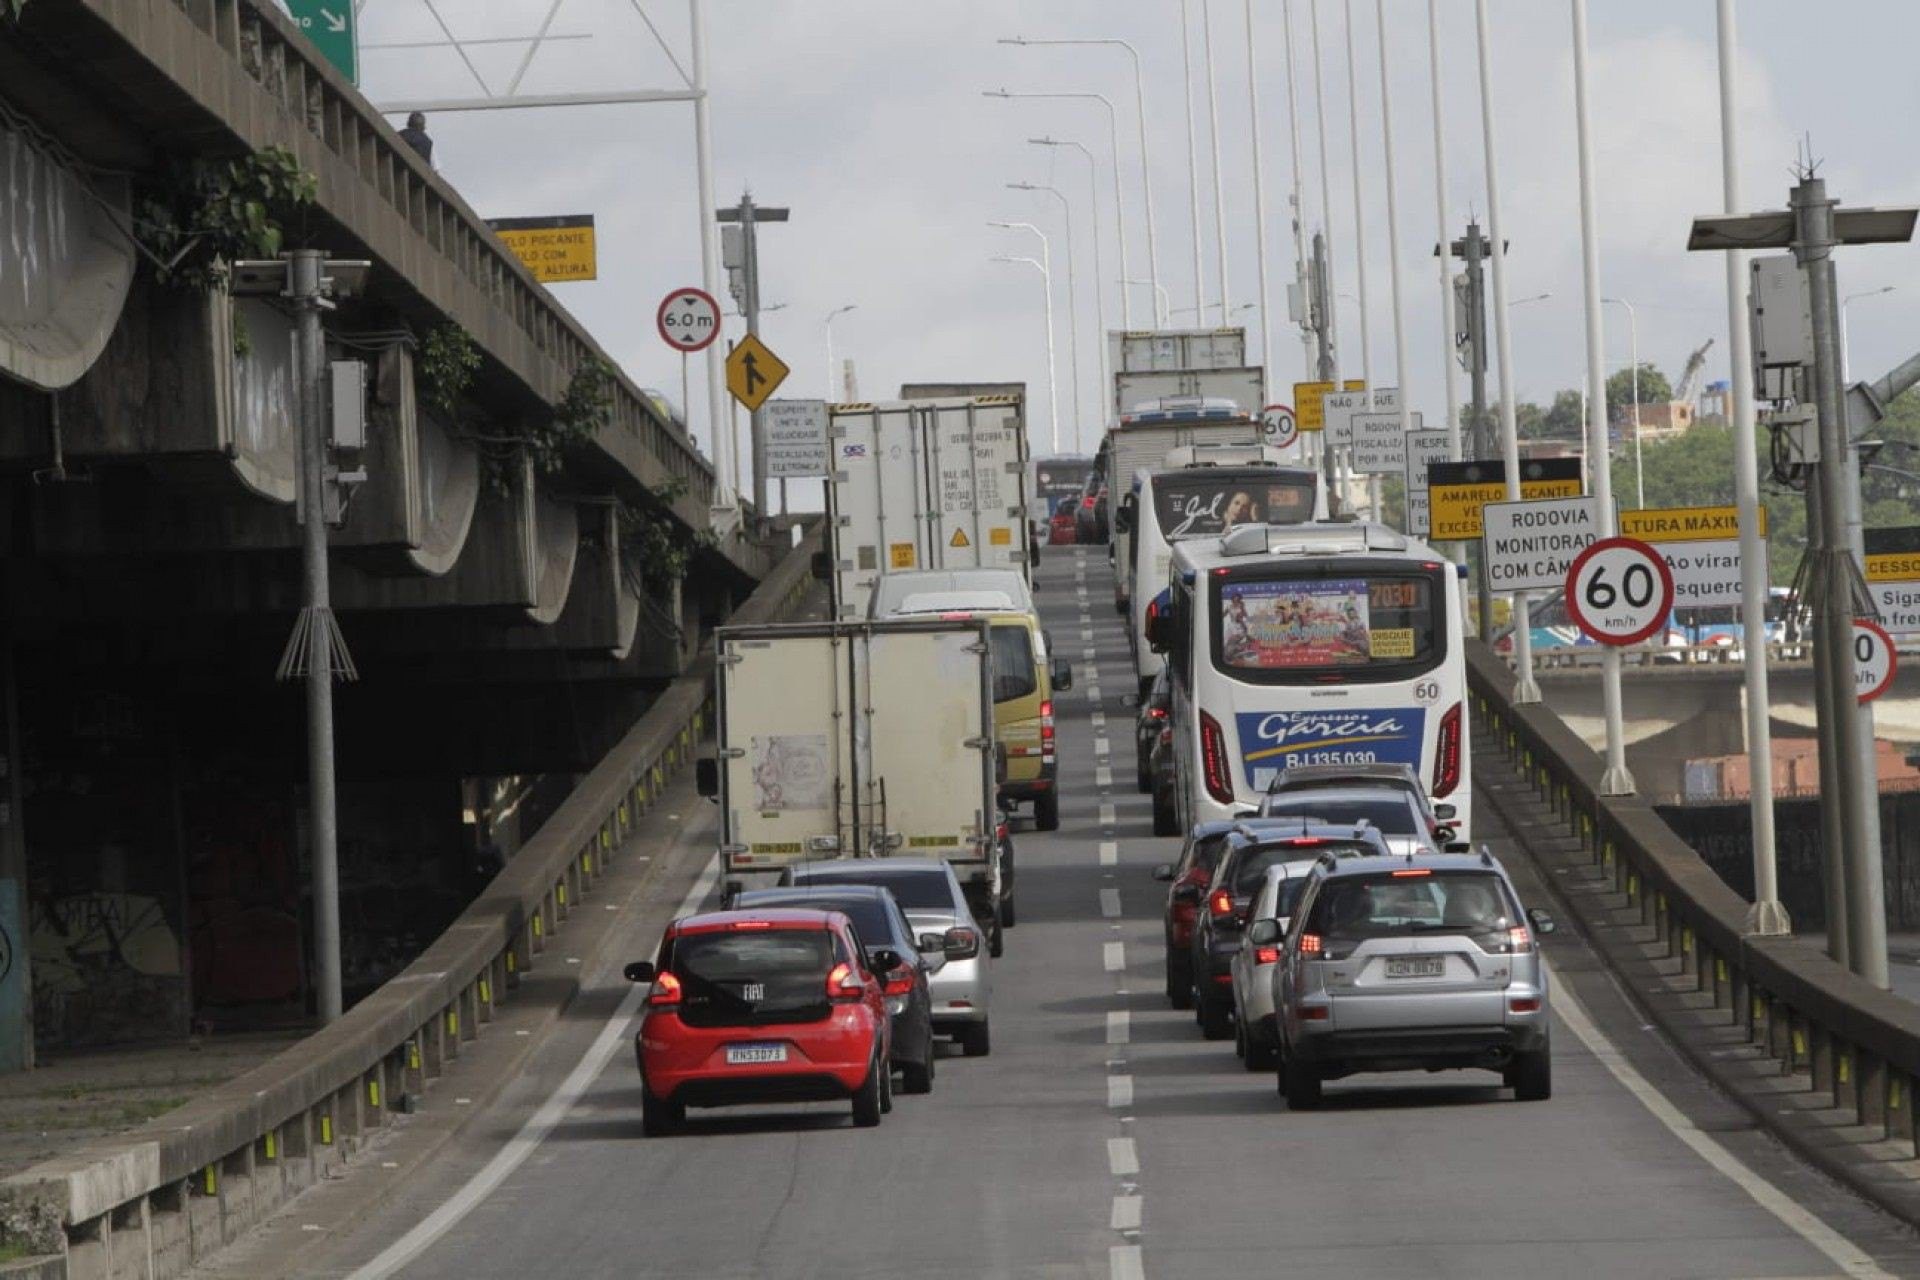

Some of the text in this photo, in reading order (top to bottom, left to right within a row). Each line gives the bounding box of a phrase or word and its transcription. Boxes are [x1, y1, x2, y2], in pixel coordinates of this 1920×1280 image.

[543, 249, 567, 259] COM
[544, 262, 589, 275] ALTURA
[665, 312, 712, 327] 6.0 m
[1330, 394, 1395, 408] NÃO JGUE
[1264, 415, 1292, 435] 60
[1366, 422, 1401, 433] RODOVI
[1414, 437, 1449, 449] RESPE
[1441, 489, 1503, 502] AMARELO
[1512, 509, 1589, 528] RODOVIA
[1622, 518, 1681, 534] LTURA
[1664, 555, 1690, 570] Ao
[1491, 563, 1528, 580] COM
[1586, 563, 1654, 609] 60
[1605, 617, 1637, 628] km/h
[1415, 683, 1438, 699] 60
[744, 984, 765, 1000] FIAT
